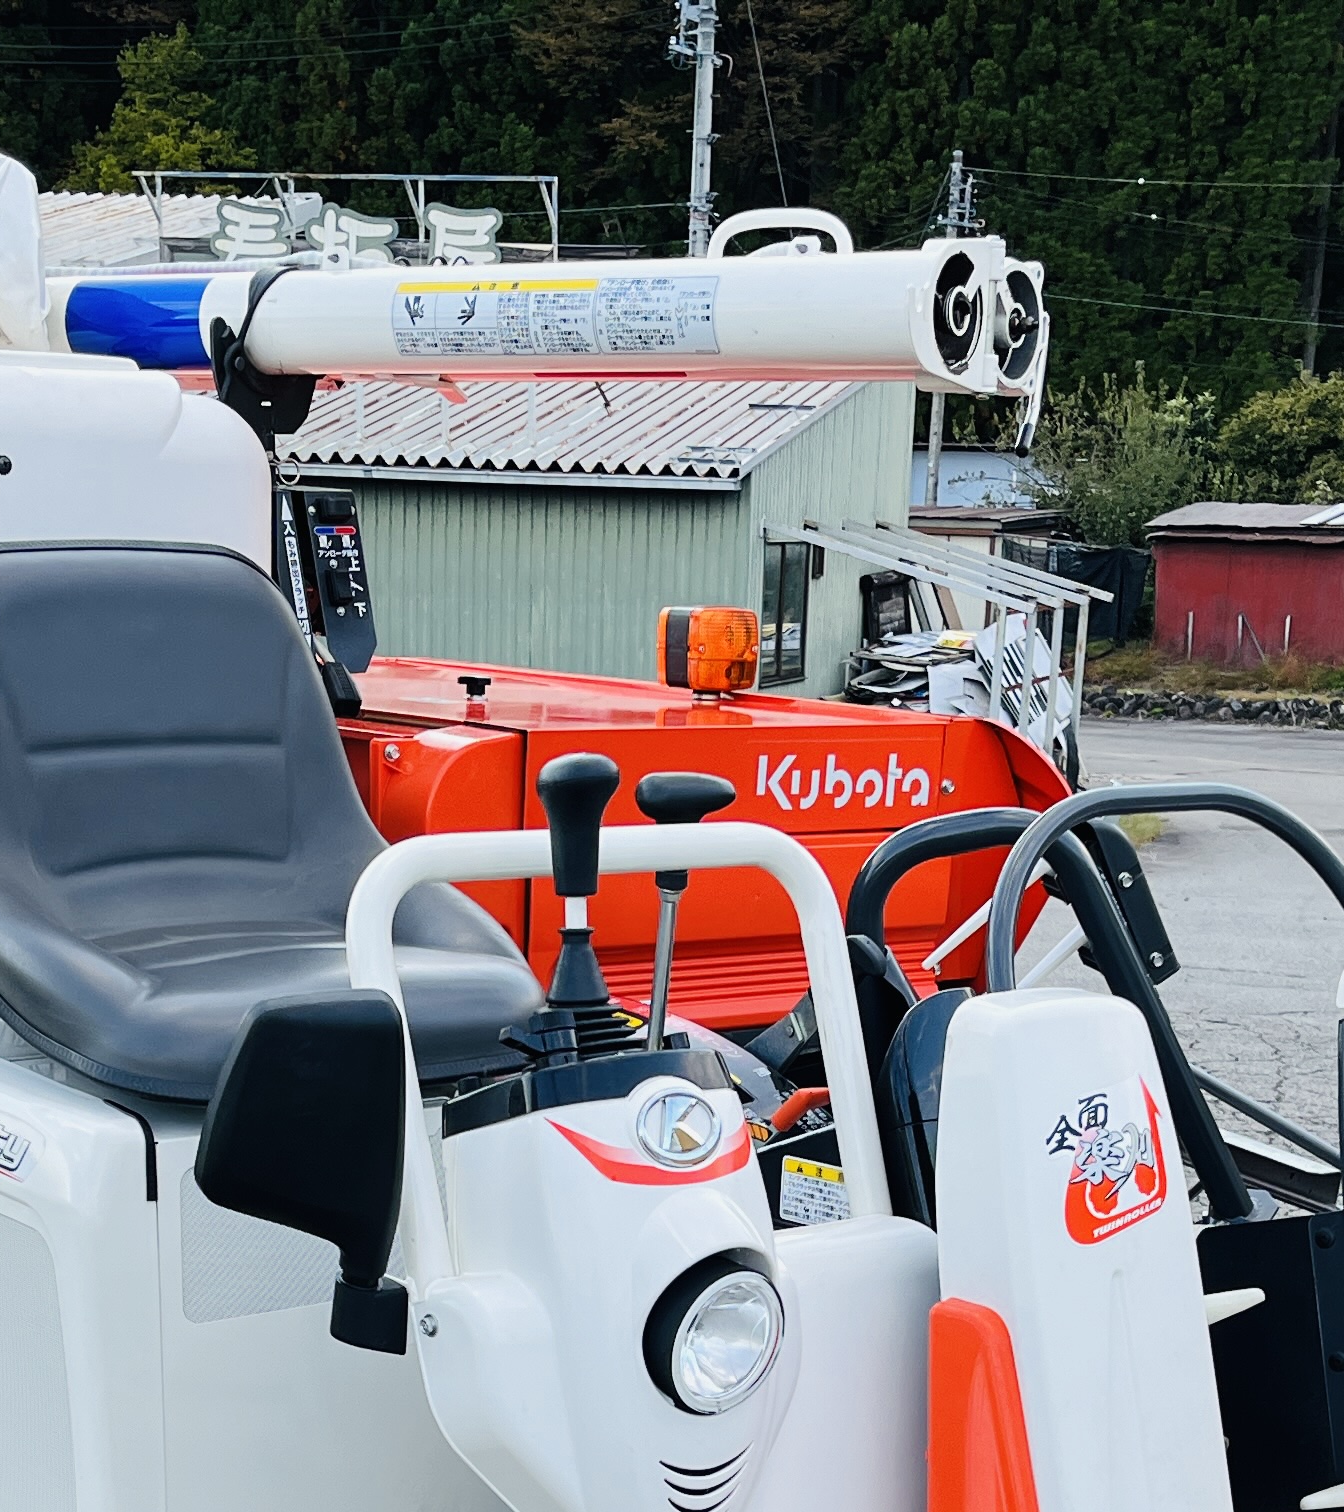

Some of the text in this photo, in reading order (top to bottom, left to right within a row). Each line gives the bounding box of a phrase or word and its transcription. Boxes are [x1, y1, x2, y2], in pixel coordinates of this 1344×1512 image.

[283, 522, 295, 536] 入
[348, 557, 361, 572] 上
[354, 602, 367, 617] 下
[756, 753, 930, 810] Kubota
